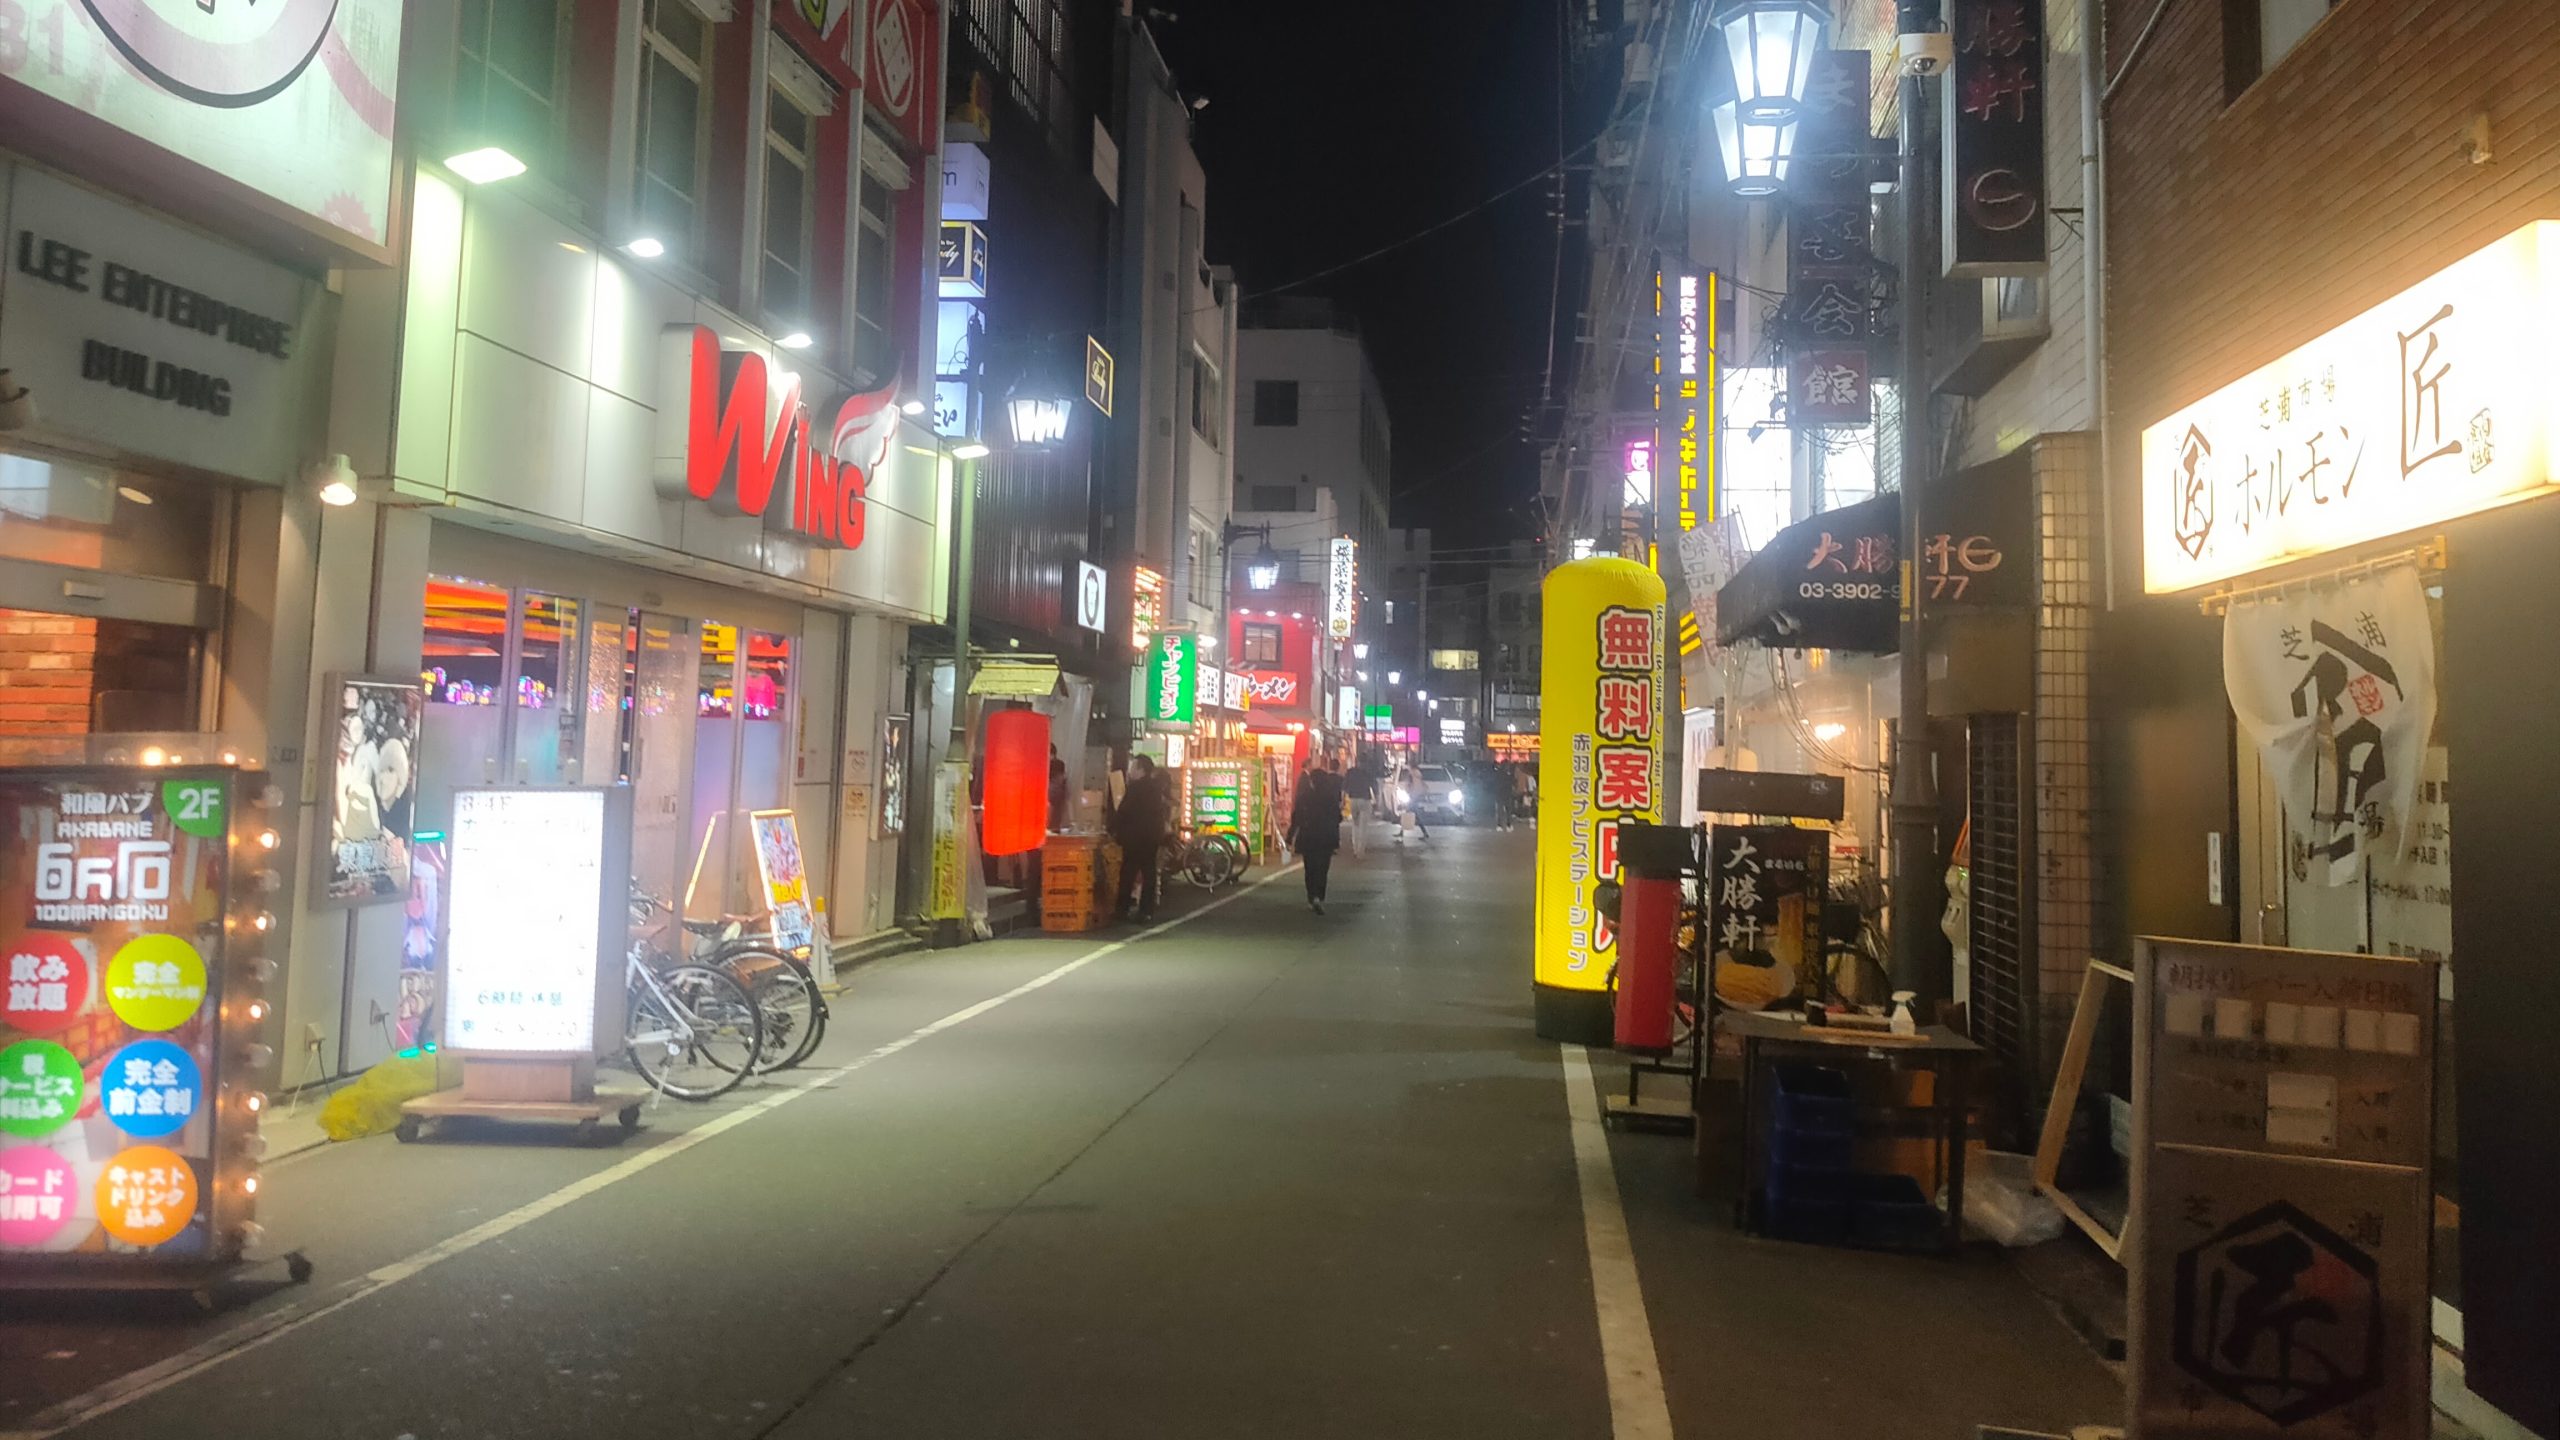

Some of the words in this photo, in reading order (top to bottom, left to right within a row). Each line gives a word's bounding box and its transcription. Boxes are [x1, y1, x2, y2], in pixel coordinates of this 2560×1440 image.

[17, 229, 92, 293] LEE
[100, 260, 293, 360] ENTERPRISE
[80, 337, 234, 418] BUILDING
[2235, 423, 2366, 537] ホルモン
[2396, 302, 2463, 482] 匠
[2280, 626, 2310, 661] 芝
[2354, 610, 2388, 649] 浦
[177, 788, 220, 820] 2F
[57, 821, 153, 839] AKABANE
[1568, 733, 1592, 972] 赤羽夜ナビステーション
[1718, 836, 1762, 952] 大勝軒
[35, 904, 169, 922] 100MANGOKU
[9, 953, 70, 982] 飲み
[132, 960, 181, 986] 完全
[7, 982, 68, 1012] 放題
[123, 1058, 180, 1086] 完全
[108, 1087, 193, 1116] 前金制
[108, 1165, 186, 1187] キャスト
[110, 1186, 186, 1208] ドリンク
[124, 1206, 165, 1228] 込み
